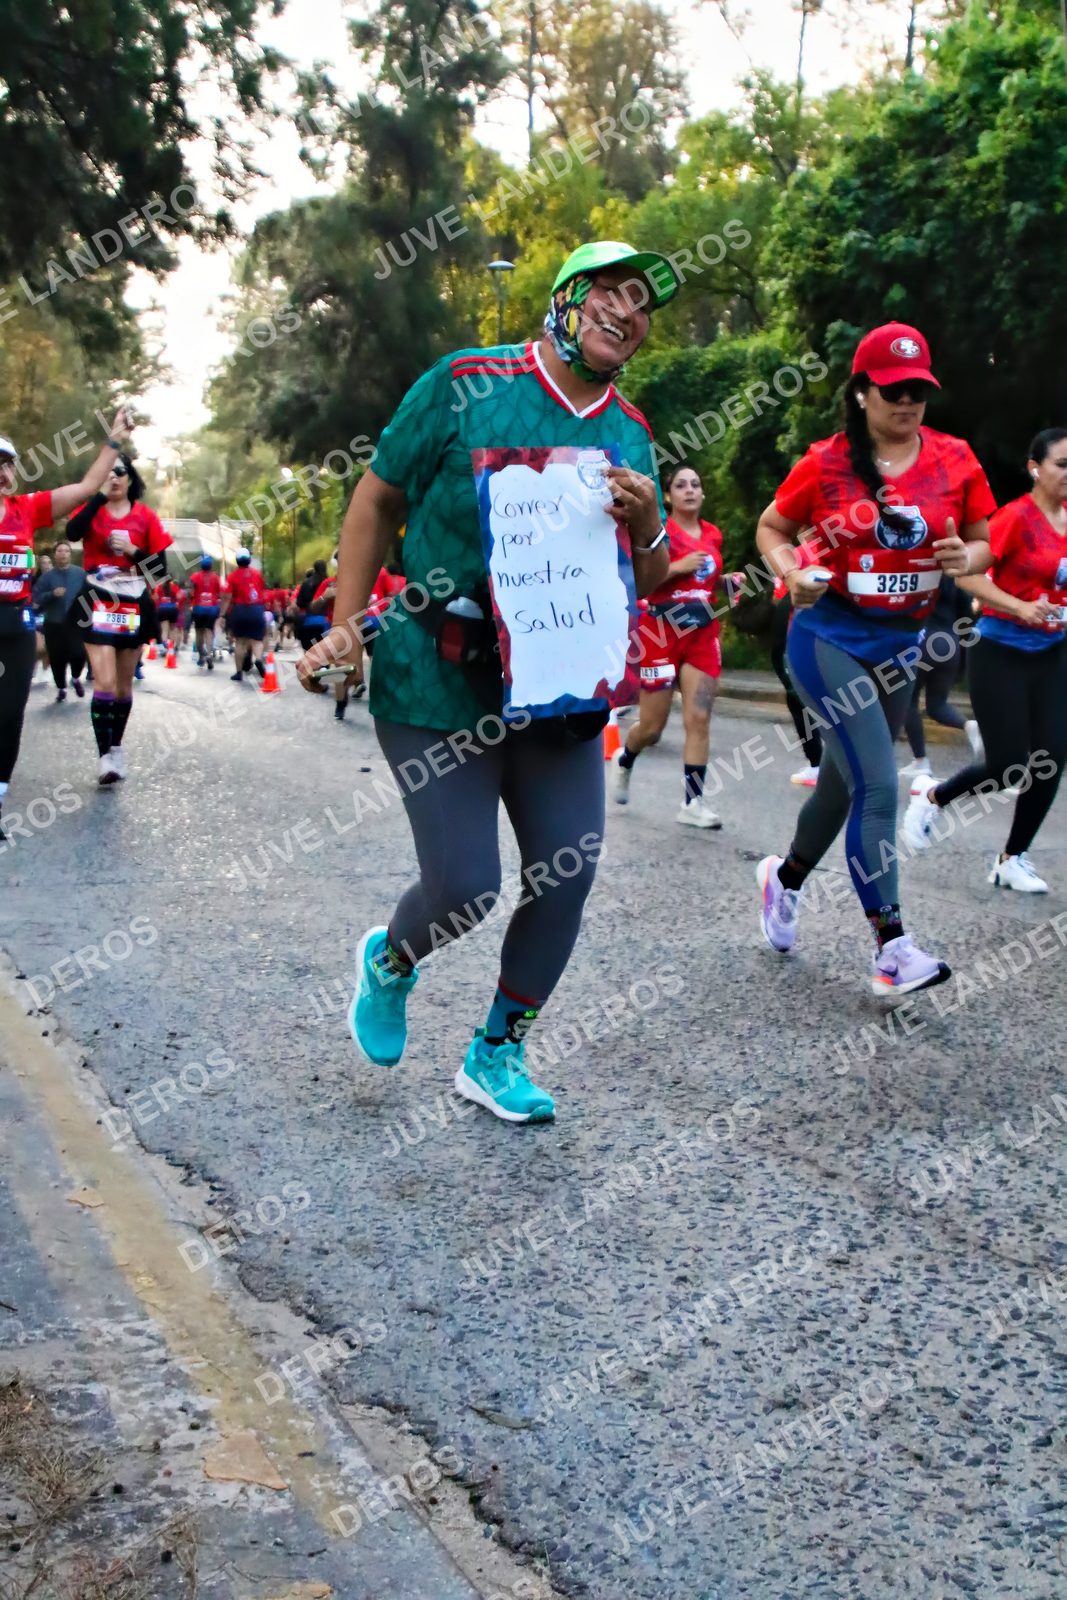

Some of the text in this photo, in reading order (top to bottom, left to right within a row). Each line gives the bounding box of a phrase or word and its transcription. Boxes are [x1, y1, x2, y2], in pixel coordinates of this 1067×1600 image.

[501, 531, 533, 559] por
[496, 560, 591, 588] nuestra
[877, 573, 919, 593] 3259
[514, 592, 595, 634] Salud
